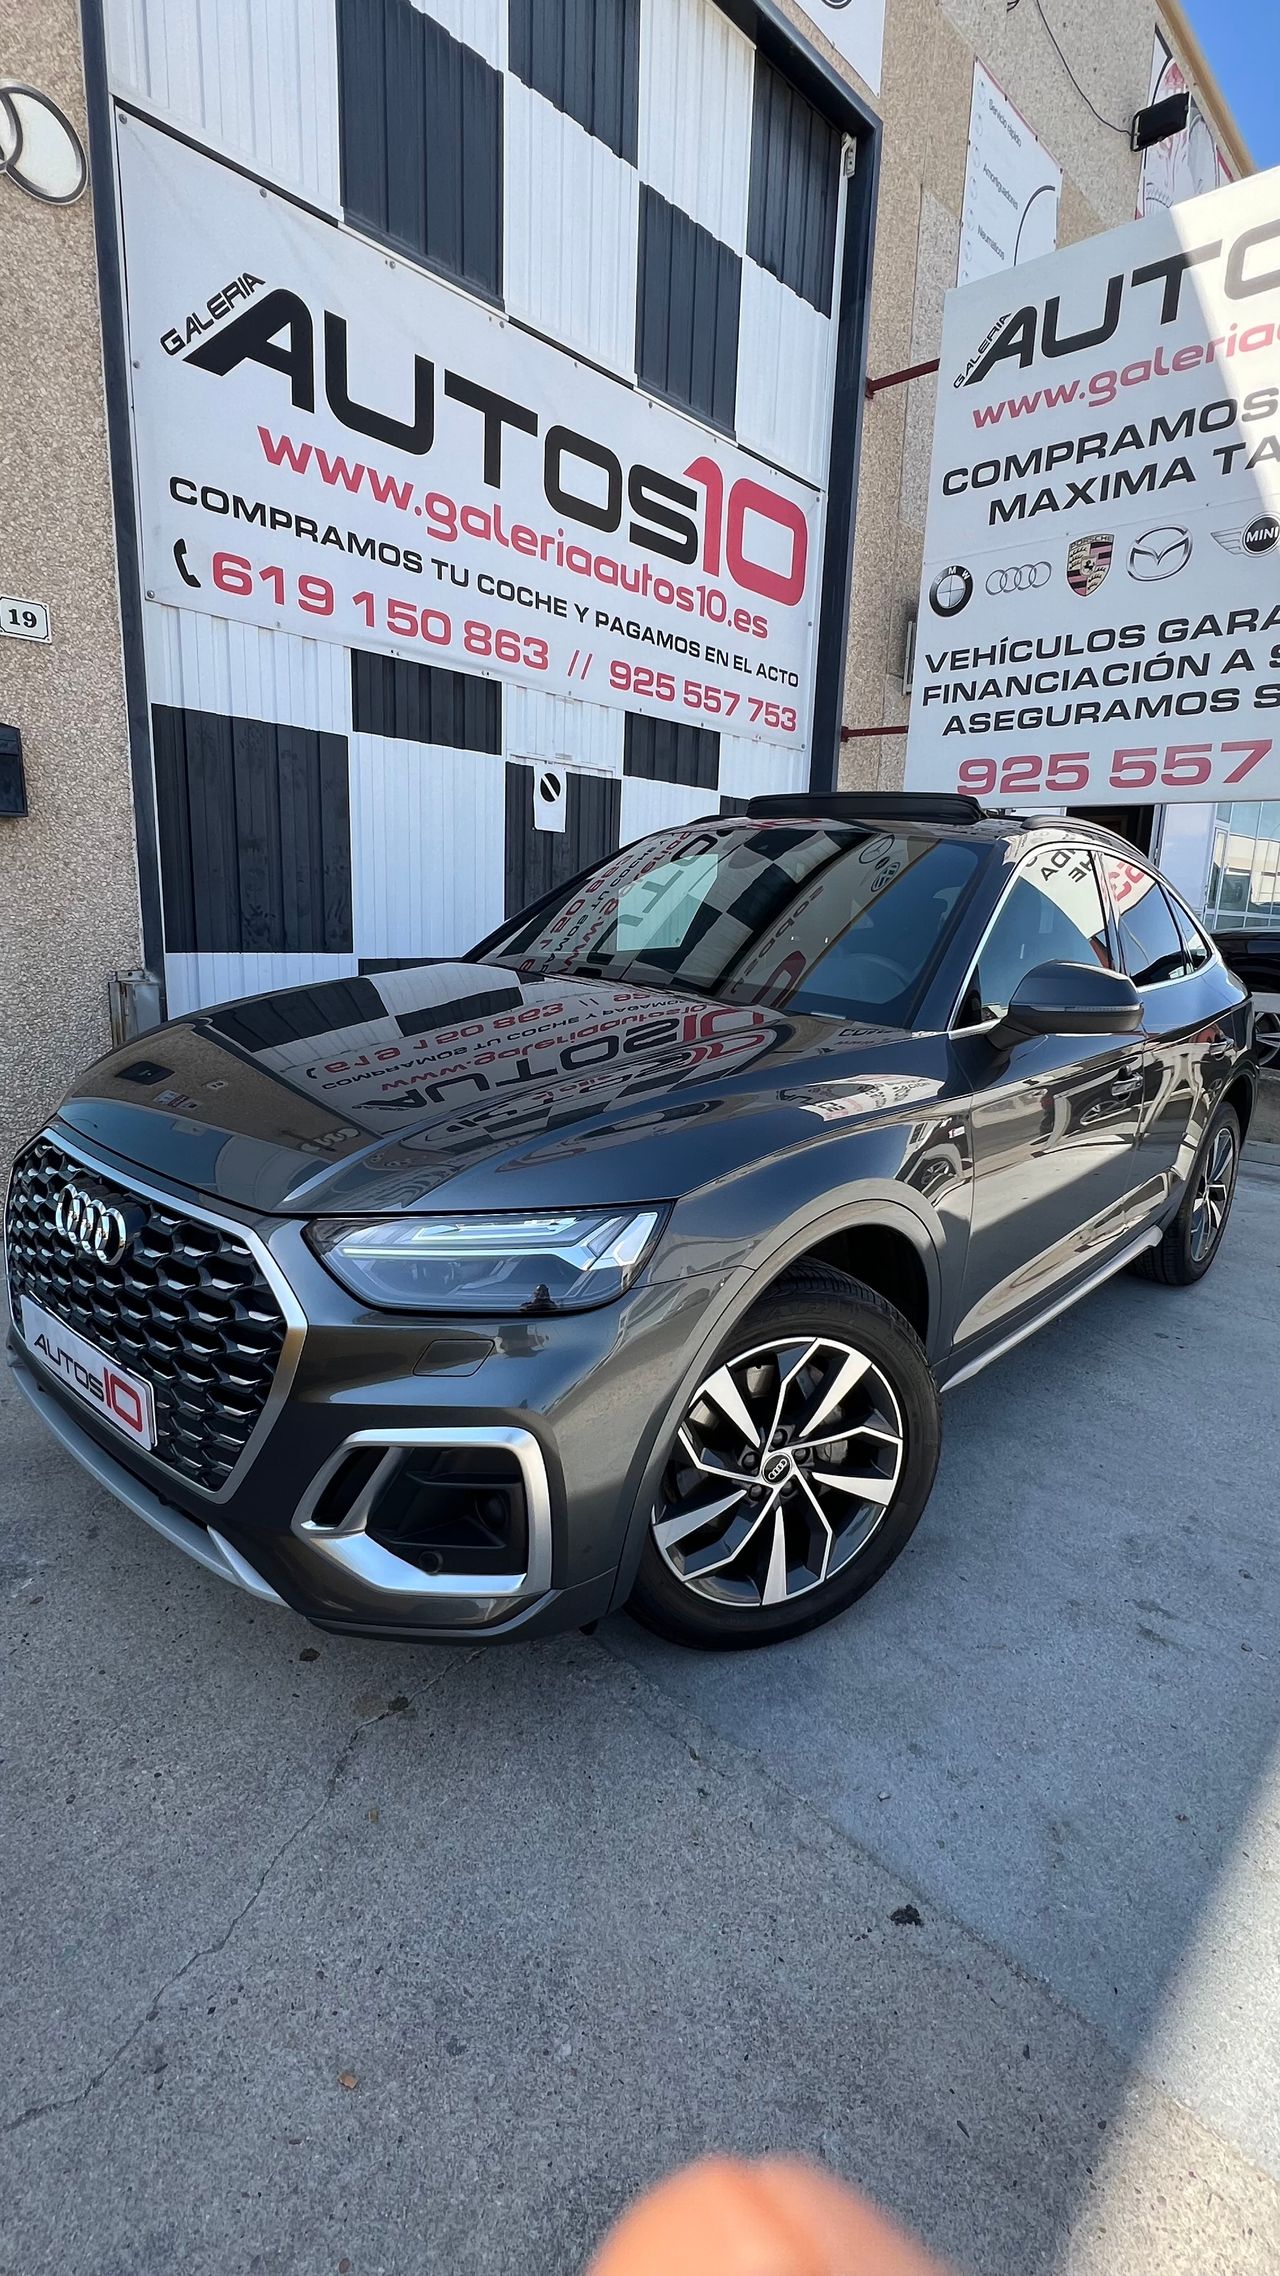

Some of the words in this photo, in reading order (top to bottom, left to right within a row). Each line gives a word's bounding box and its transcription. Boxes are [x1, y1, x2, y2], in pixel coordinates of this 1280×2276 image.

[160, 272, 265, 356] GALERIA
[953, 312, 1012, 389] GALERIA
[972, 322, 1280, 428] www.galeria
[942, 387, 1279, 497] COMPRAMOS
[988, 458, 1196, 526] MAXIMA
[257, 425, 769, 639] www.galeriaautos10.es
[1245, 526, 1279, 543] MINI
[169, 476, 423, 574] COMPRAMOS
[431, 558, 469, 588] TU
[477, 573, 568, 619] COCHE
[574, 603, 590, 623] Y
[595, 611, 701, 659] PAGAMOS
[704, 645, 729, 667] EN
[733, 654, 752, 674] EL
[755, 662, 799, 688] ACTO
[8, 608, 37, 629] 19
[211, 552, 336, 617] 619
[352, 590, 453, 646] 150
[463, 620, 550, 671] 863
[609, 660, 676, 702] 925
[683, 681, 740, 718] 557
[747, 697, 797, 732] 753
[925, 624, 1147, 673] VEHÍCULOS
[922, 651, 1211, 707] FINANCIACIÓN
[1221, 648, 1255, 674] A
[942, 688, 1240, 736] ASEGURAMOS
[957, 752, 1090, 796] 925
[1108, 739, 1273, 789] 557
